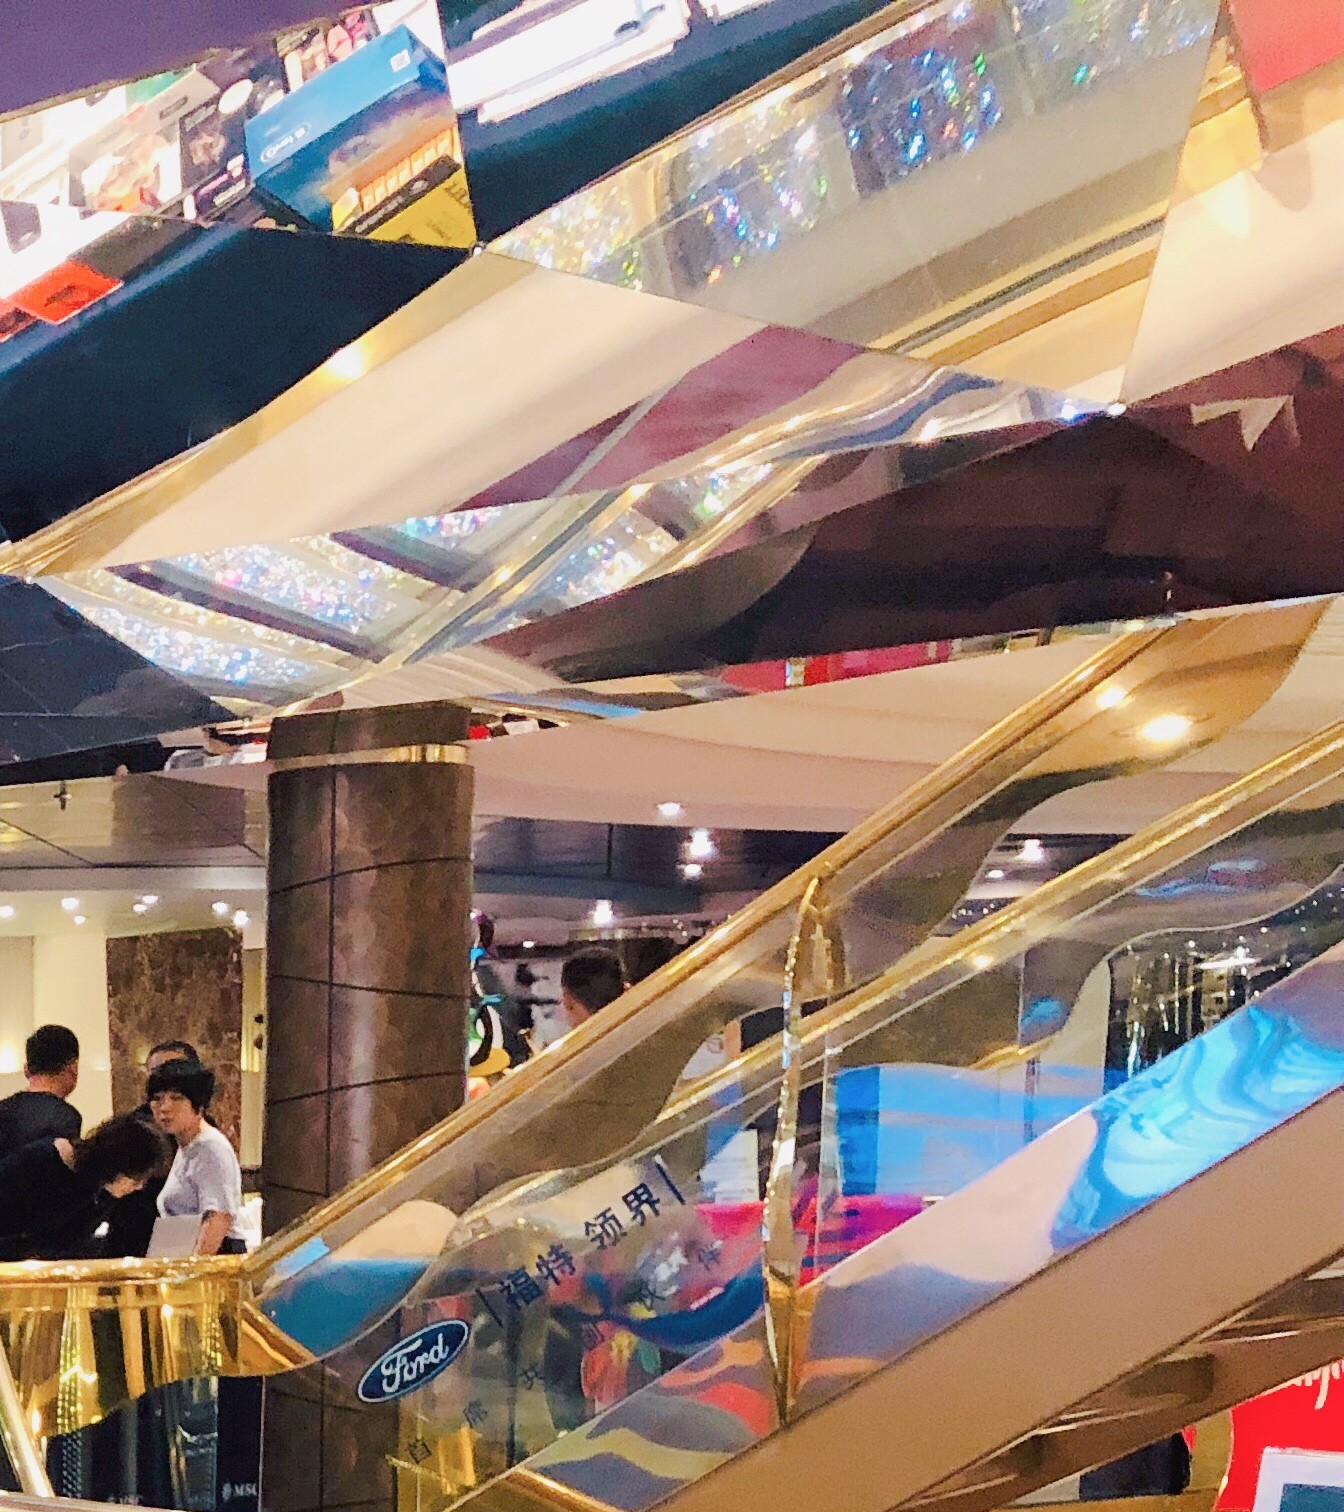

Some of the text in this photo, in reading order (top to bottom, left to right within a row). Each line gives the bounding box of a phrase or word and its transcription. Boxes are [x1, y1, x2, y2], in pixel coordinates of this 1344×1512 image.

[498, 1182, 661, 1311] 福特 领界
[380, 1333, 451, 1394] Ford
